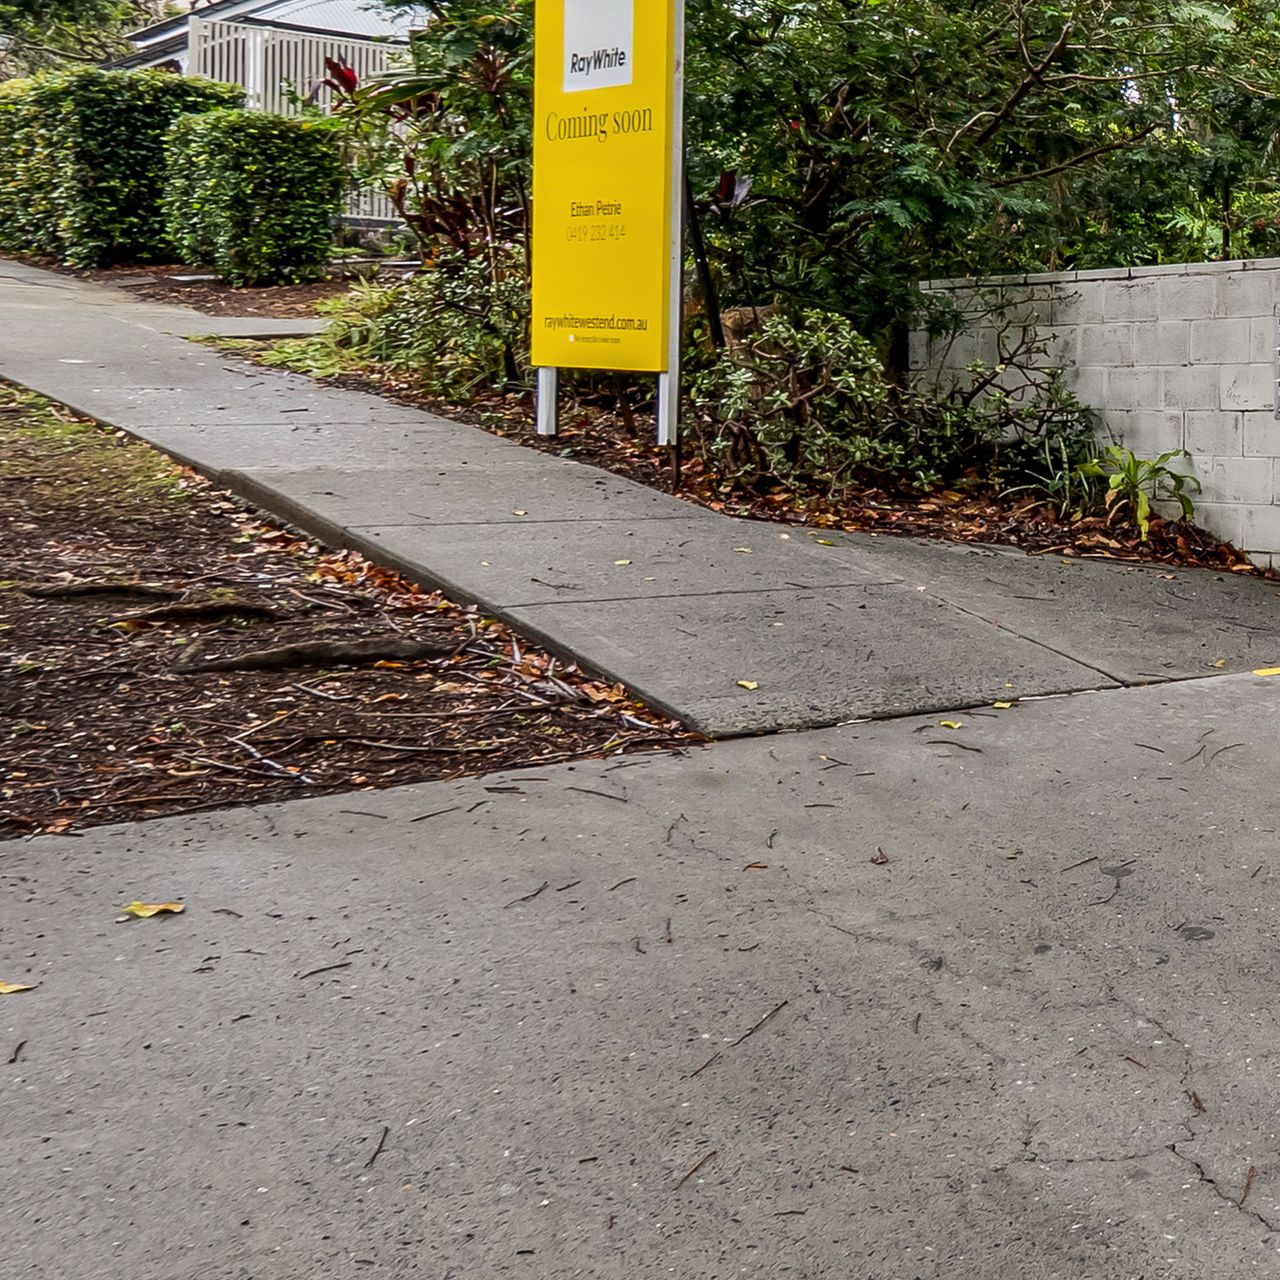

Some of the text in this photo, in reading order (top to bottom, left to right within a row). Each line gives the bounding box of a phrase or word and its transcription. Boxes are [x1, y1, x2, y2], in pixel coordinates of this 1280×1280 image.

[546, 106, 652, 143] Coming soon
[571, 199, 621, 217] Ethan Petrie
